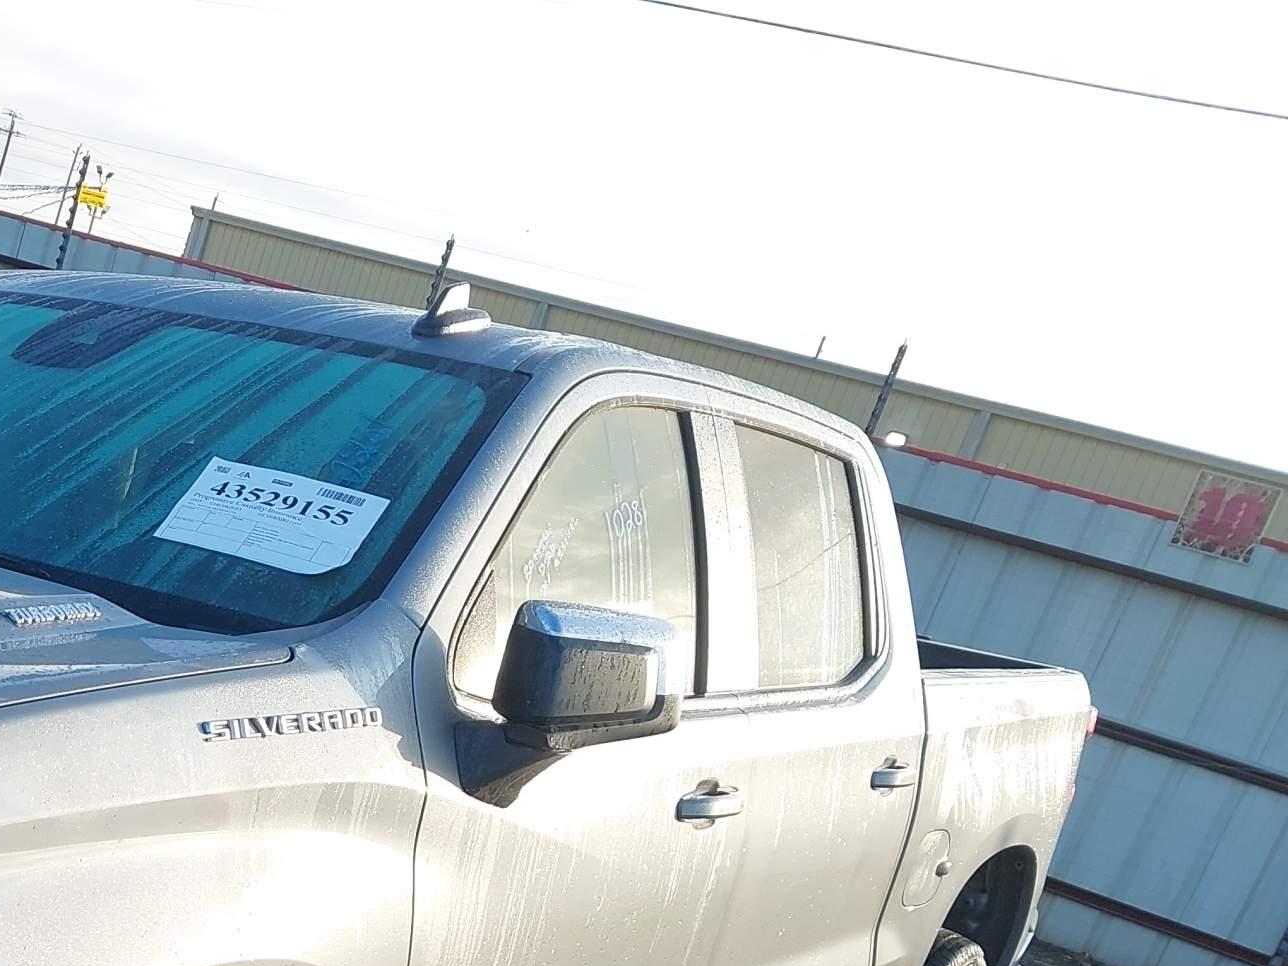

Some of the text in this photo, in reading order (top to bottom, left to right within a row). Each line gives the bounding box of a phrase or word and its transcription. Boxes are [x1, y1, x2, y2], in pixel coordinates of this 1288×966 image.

[209, 480, 354, 526] 43529155
[236, 500, 267, 513] Casualty
[199, 706, 383, 742] SILVERADO
